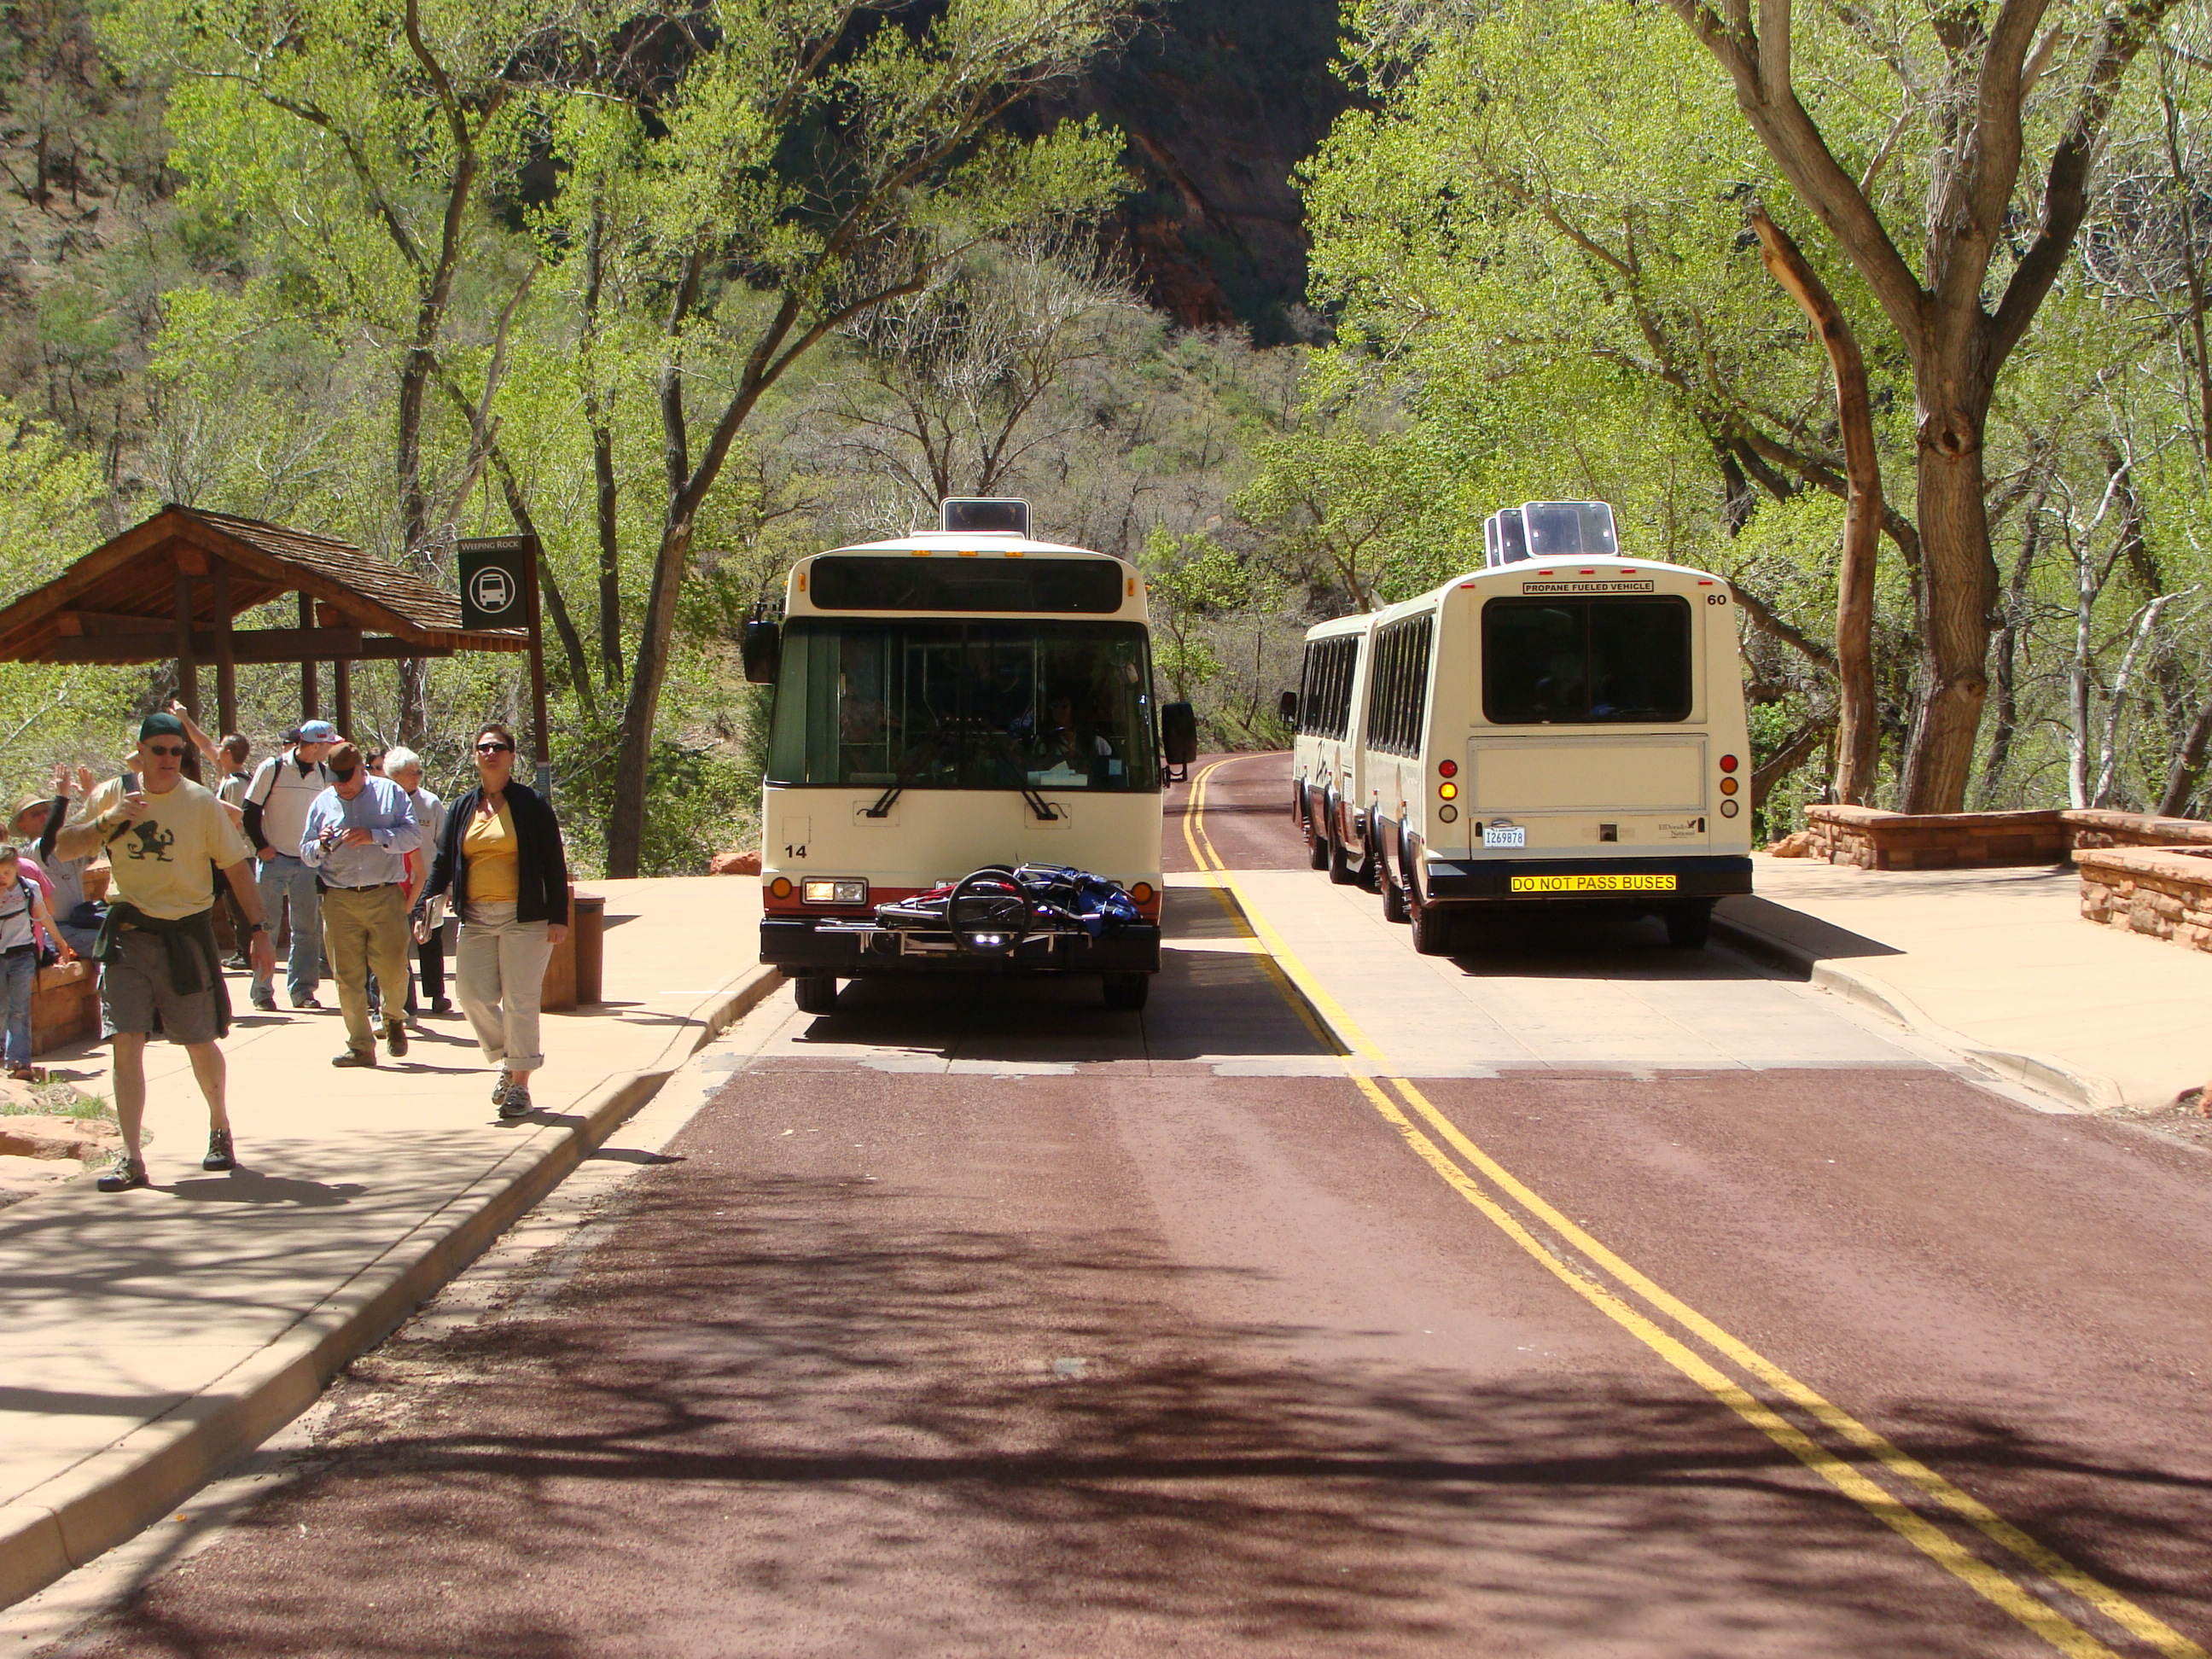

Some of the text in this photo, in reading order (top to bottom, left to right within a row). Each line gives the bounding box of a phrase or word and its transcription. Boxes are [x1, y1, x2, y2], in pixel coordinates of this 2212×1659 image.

[1707, 594, 1726, 605] 60
[1487, 832, 1523, 843] I269878
[785, 845, 807, 859] 14
[1512, 876, 1674, 891] DO NOT PASS BUSES
